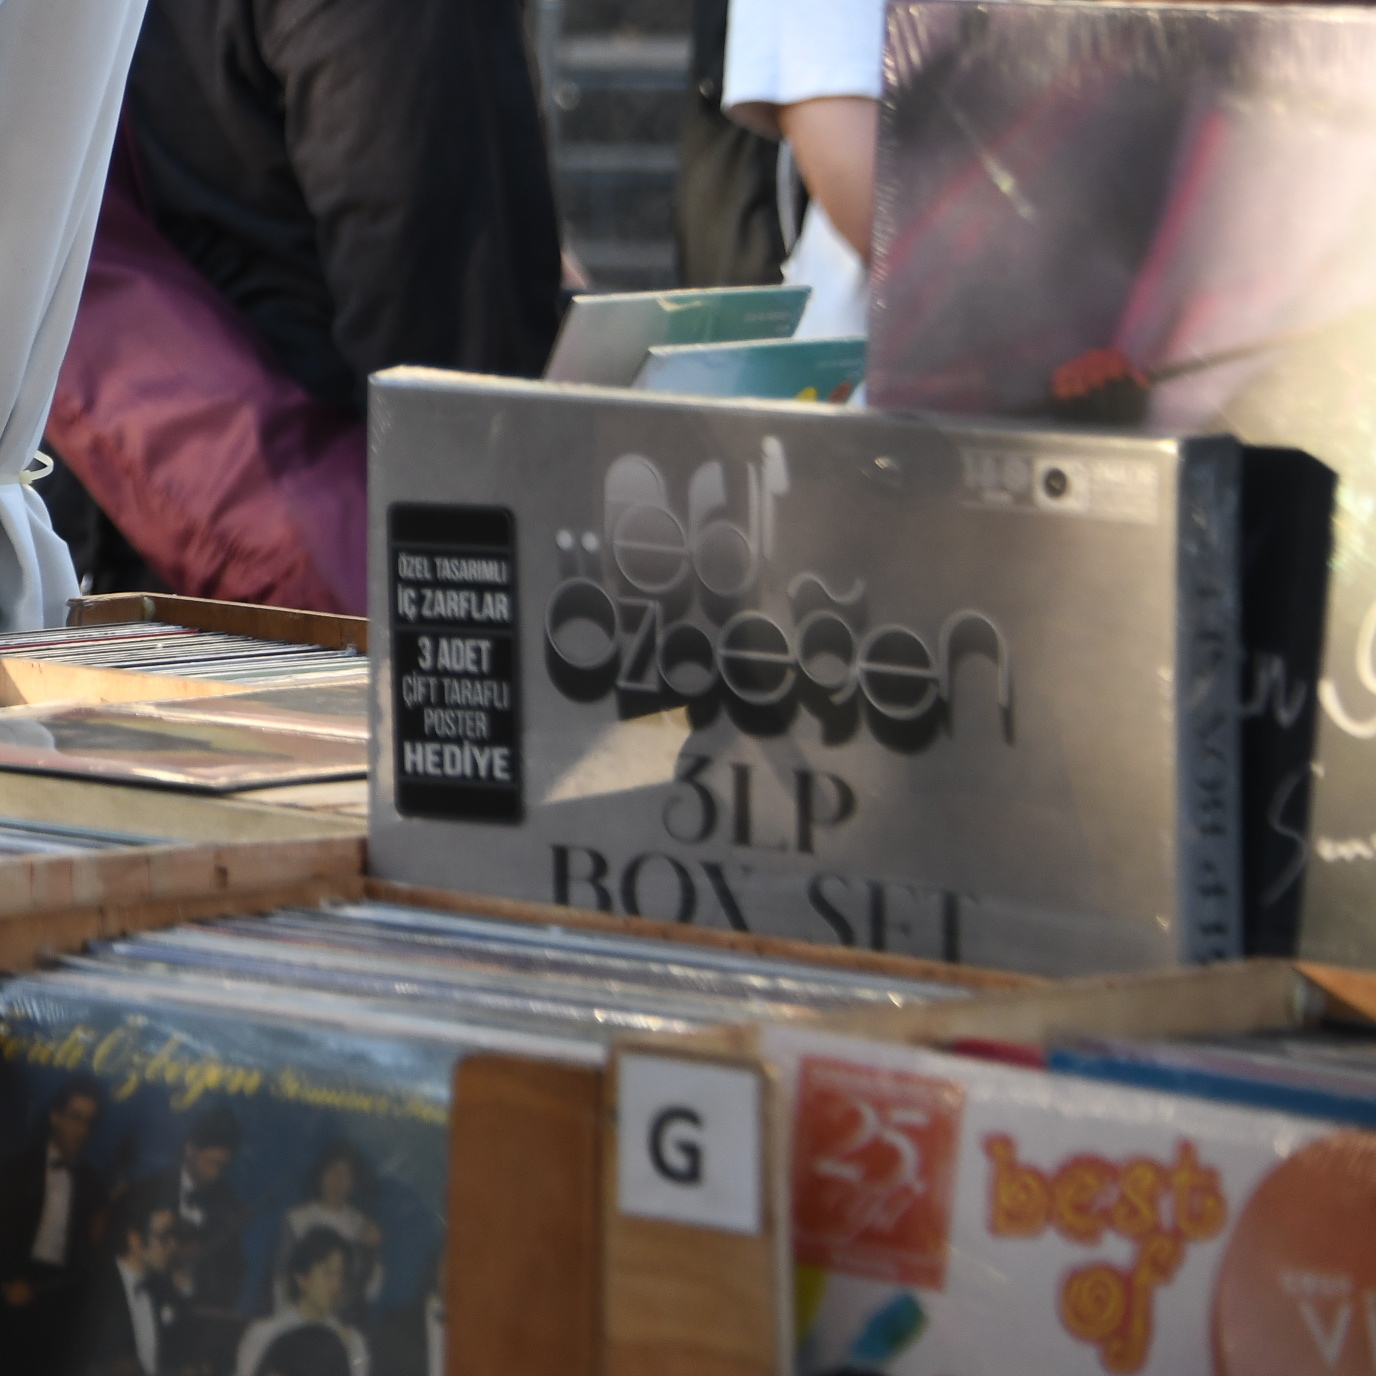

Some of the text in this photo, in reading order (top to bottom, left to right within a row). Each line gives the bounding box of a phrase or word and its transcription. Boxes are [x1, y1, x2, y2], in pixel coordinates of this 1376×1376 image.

[398, 553, 509, 584] ÖZEL TASARIMLI
[397, 583, 511, 622] İÇ ZARFLAR
[417, 635, 492, 674] 3 ADET
[401, 671, 511, 712] ÇİFT TARAFLI
[423, 707, 489, 741] POSTER
[403, 739, 511, 781] HEDİYE
[662, 752, 858, 856] 3LP
[648, 1106, 703, 1186] G
[983, 1132, 1227, 1245] best
[1059, 1233, 1184, 1376] of
